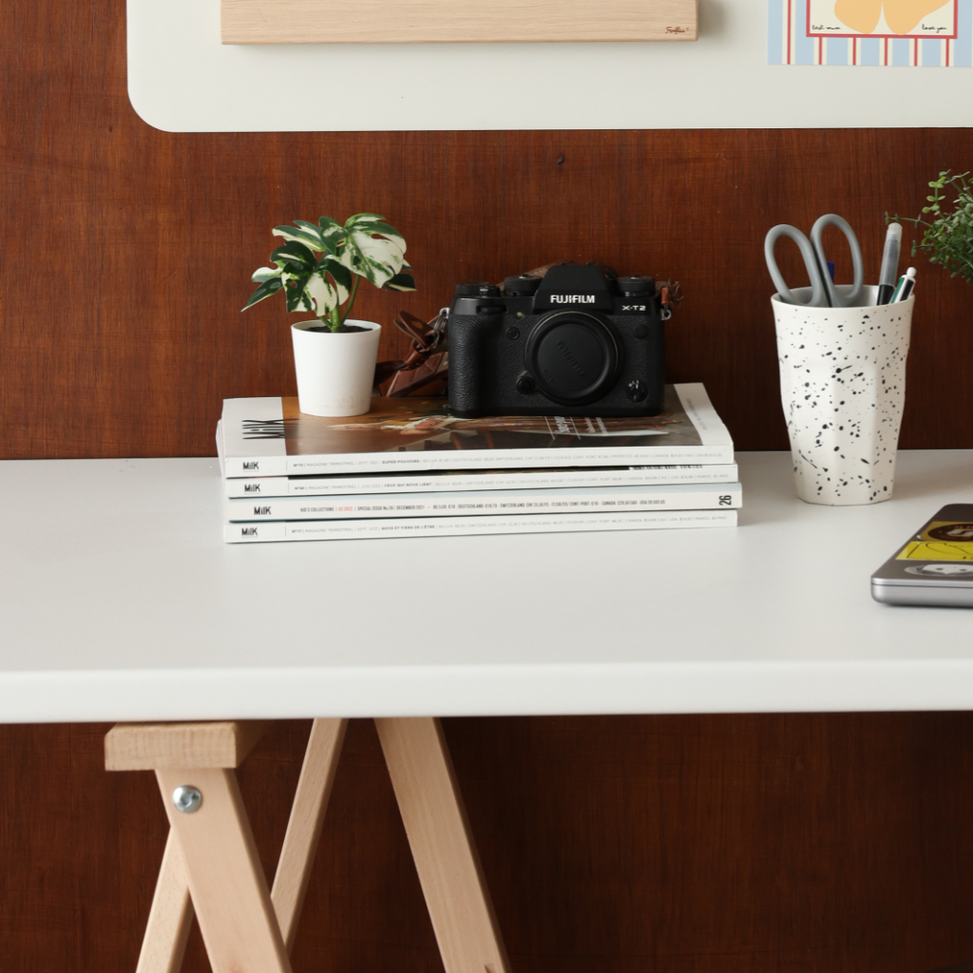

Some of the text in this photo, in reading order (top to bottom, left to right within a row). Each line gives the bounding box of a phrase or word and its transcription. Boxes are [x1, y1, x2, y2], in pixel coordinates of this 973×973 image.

[550, 294, 595, 304] FUJIFILM
[718, 495, 732, 506] 26
[254, 506, 272, 515] MilK
